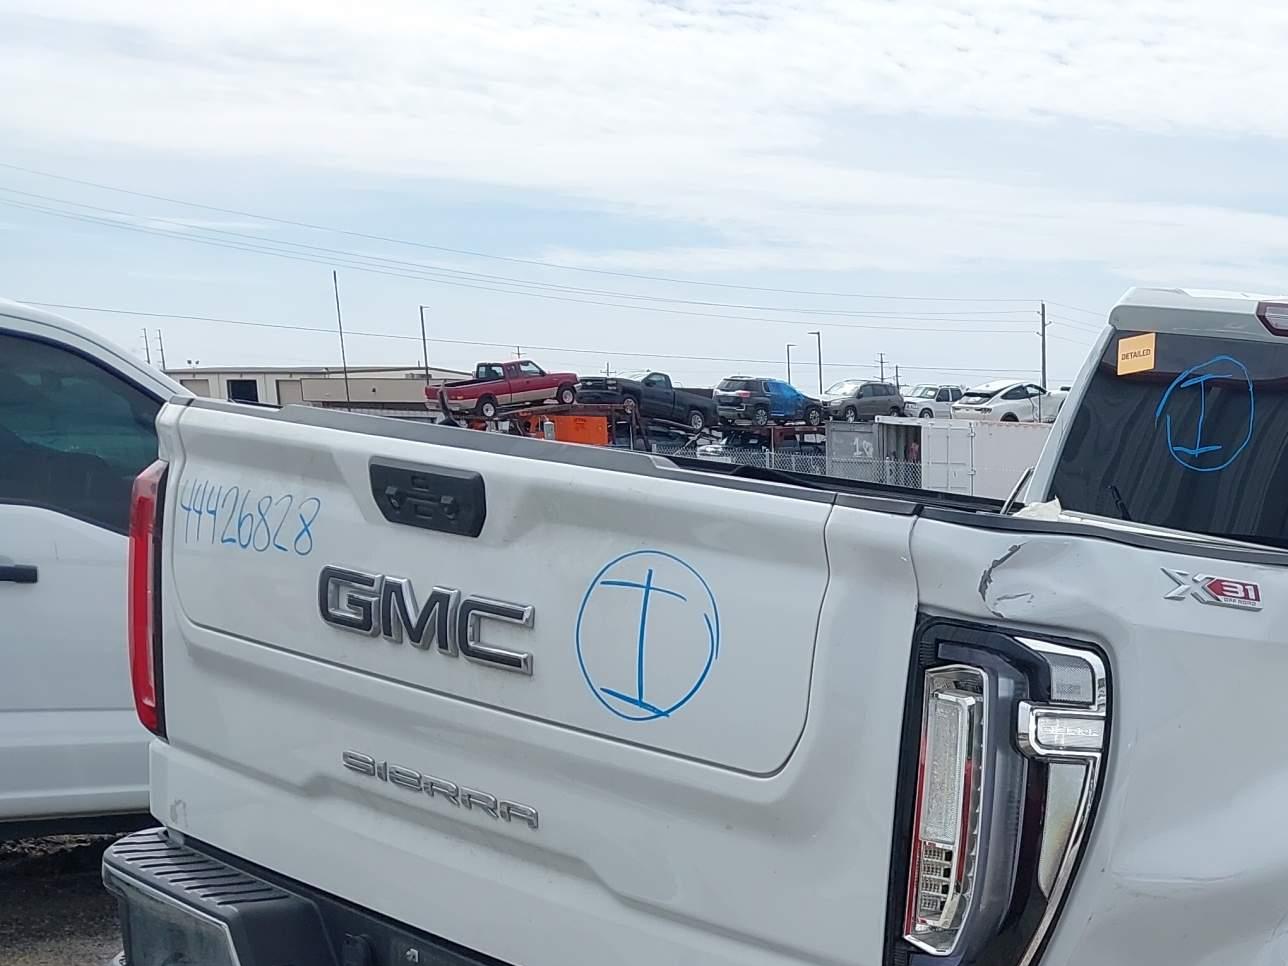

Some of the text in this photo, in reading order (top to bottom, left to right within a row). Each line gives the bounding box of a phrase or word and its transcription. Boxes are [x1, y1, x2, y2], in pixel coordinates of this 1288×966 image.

[1121, 348, 1151, 361] DETAILED
[180, 479, 321, 556] 44426828
[318, 564, 535, 677] GMC
[1160, 566, 1263, 612] X31
[342, 749, 539, 830] SIERRA
